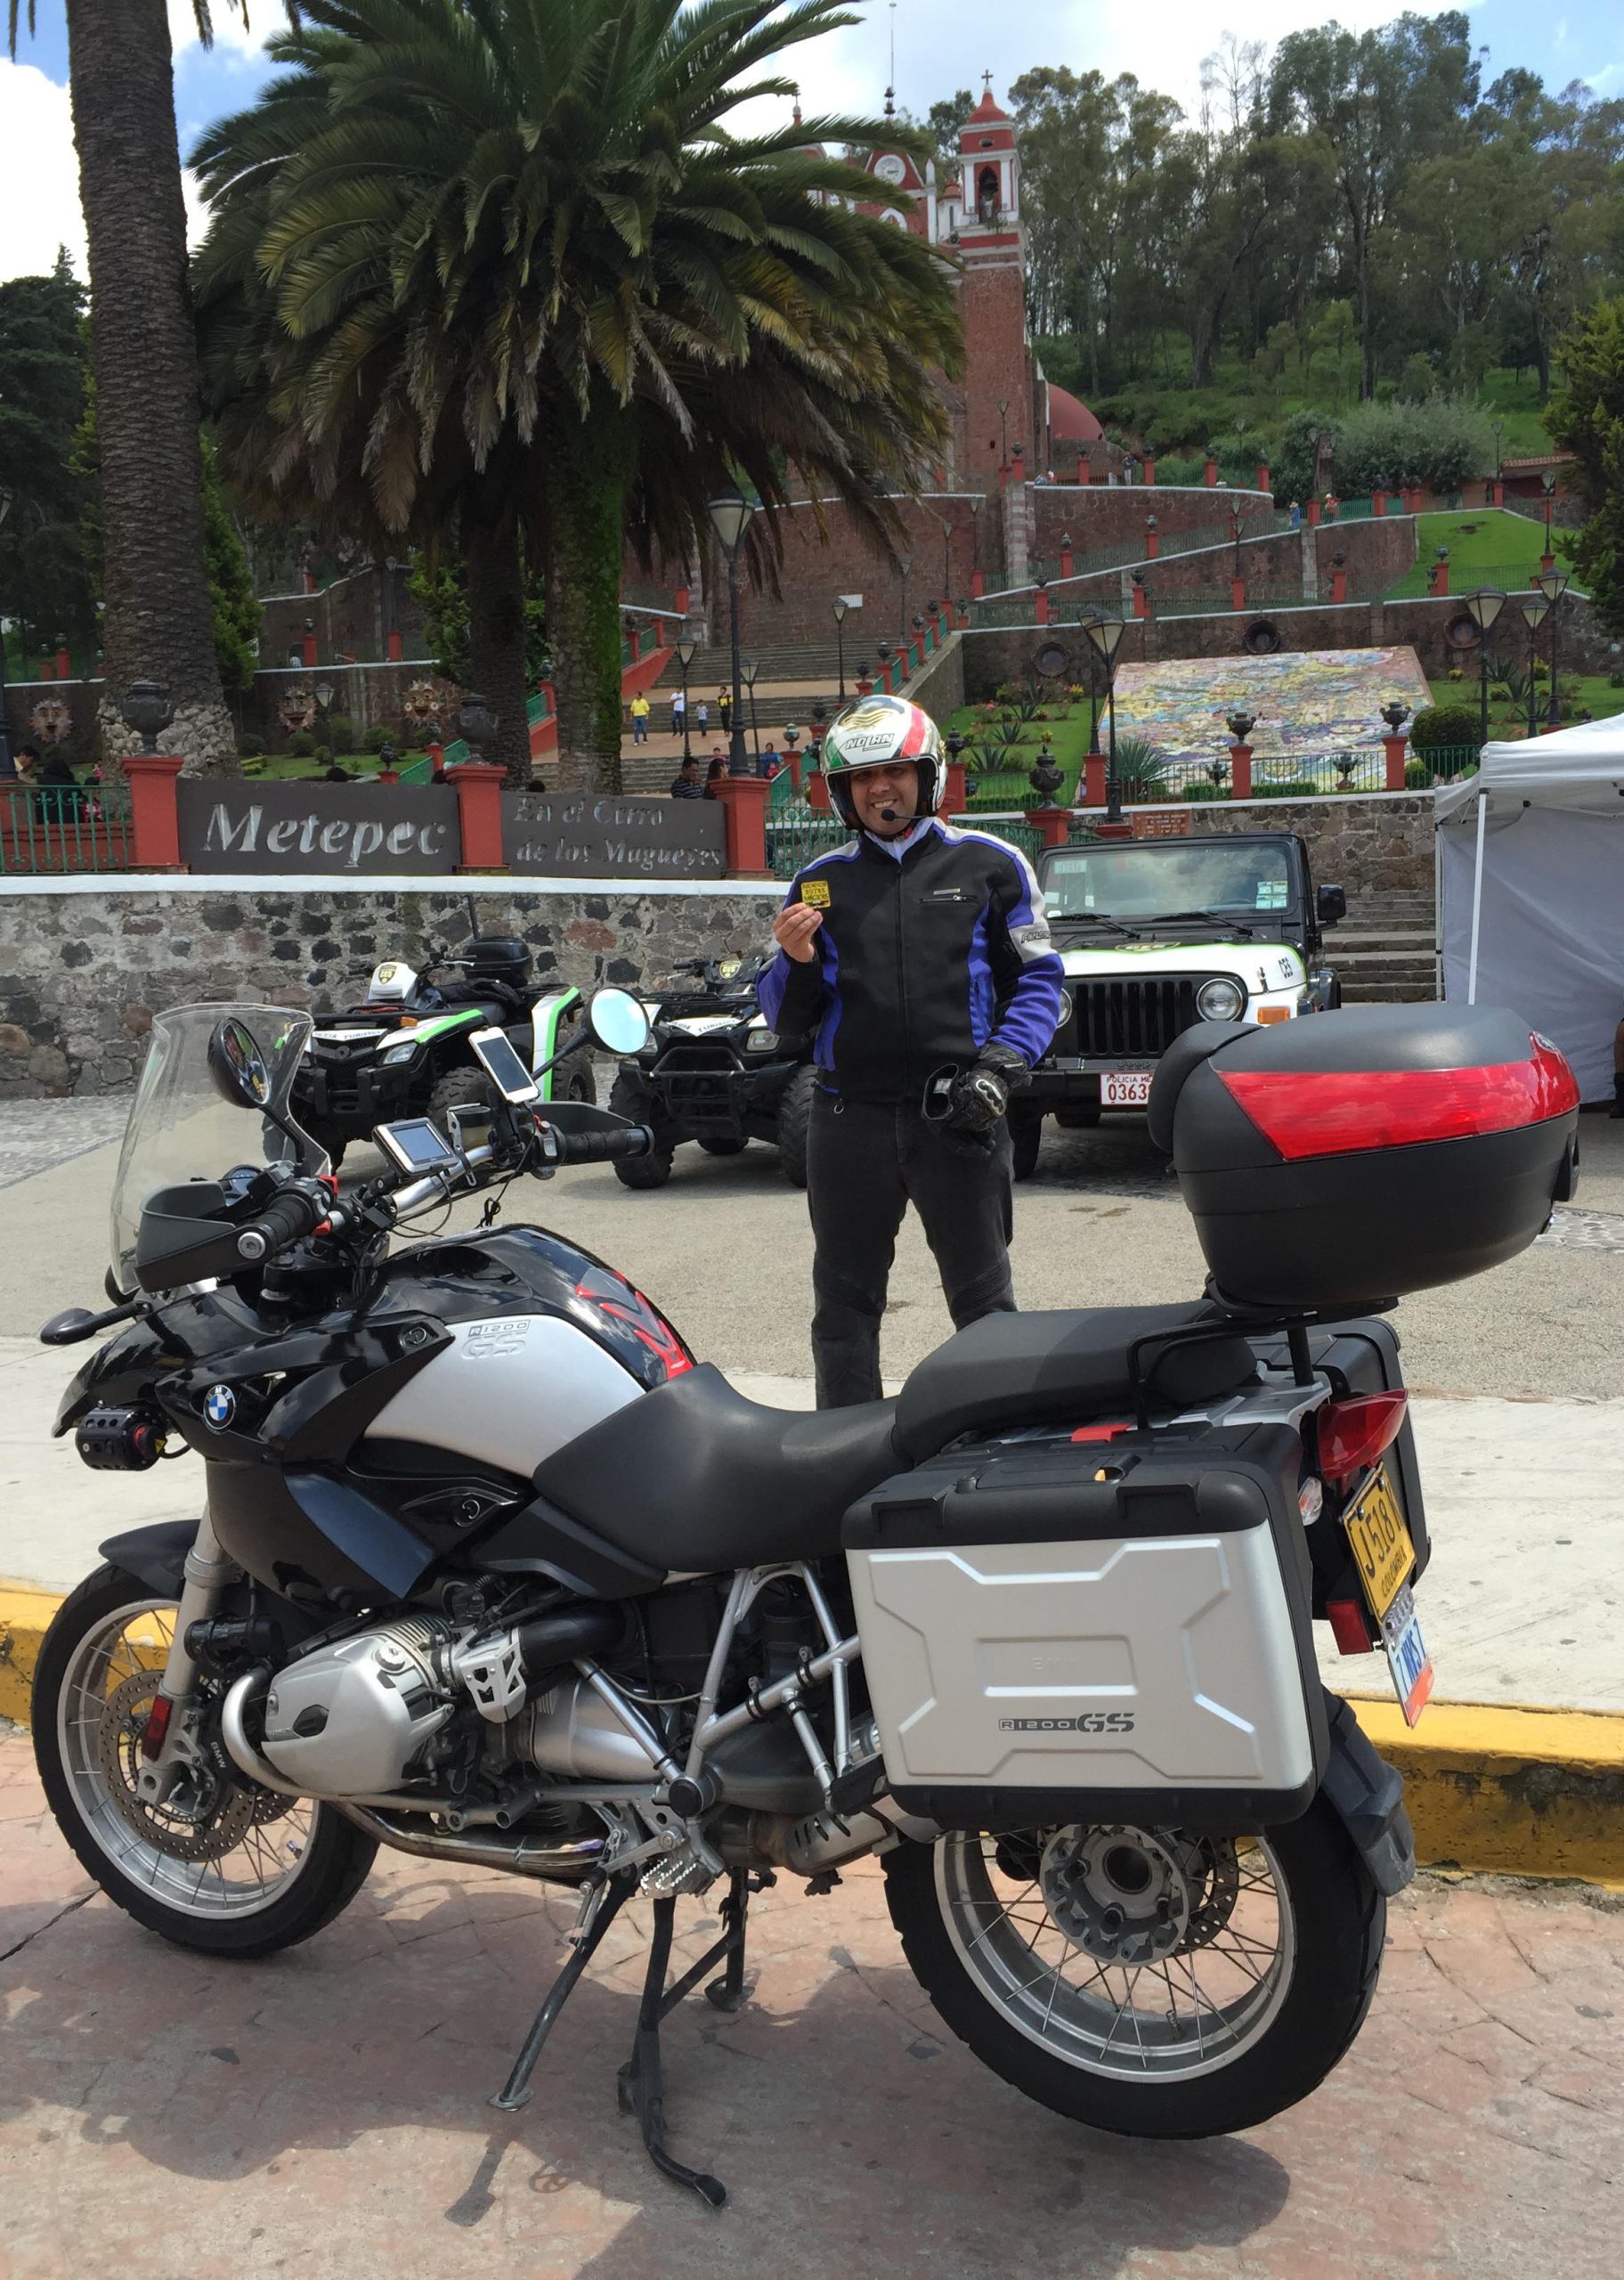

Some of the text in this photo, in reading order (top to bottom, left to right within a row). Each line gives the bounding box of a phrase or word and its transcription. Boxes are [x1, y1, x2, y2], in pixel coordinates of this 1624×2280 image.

[846, 733, 895, 752] NOLAN
[514, 795, 553, 822] En
[594, 799, 664, 826] Cerro
[200, 803, 446, 868] Metepec
[516, 837, 548, 862] de
[555, 836, 591, 863] los
[1106, 1075, 1138, 1083] POLICIA
[1108, 1083, 1152, 1101] 0363
[461, 1332, 526, 1360] GS
[1381, 1545, 1408, 1598] COLOMBIA
[210, 1741, 227, 1768] BMW
